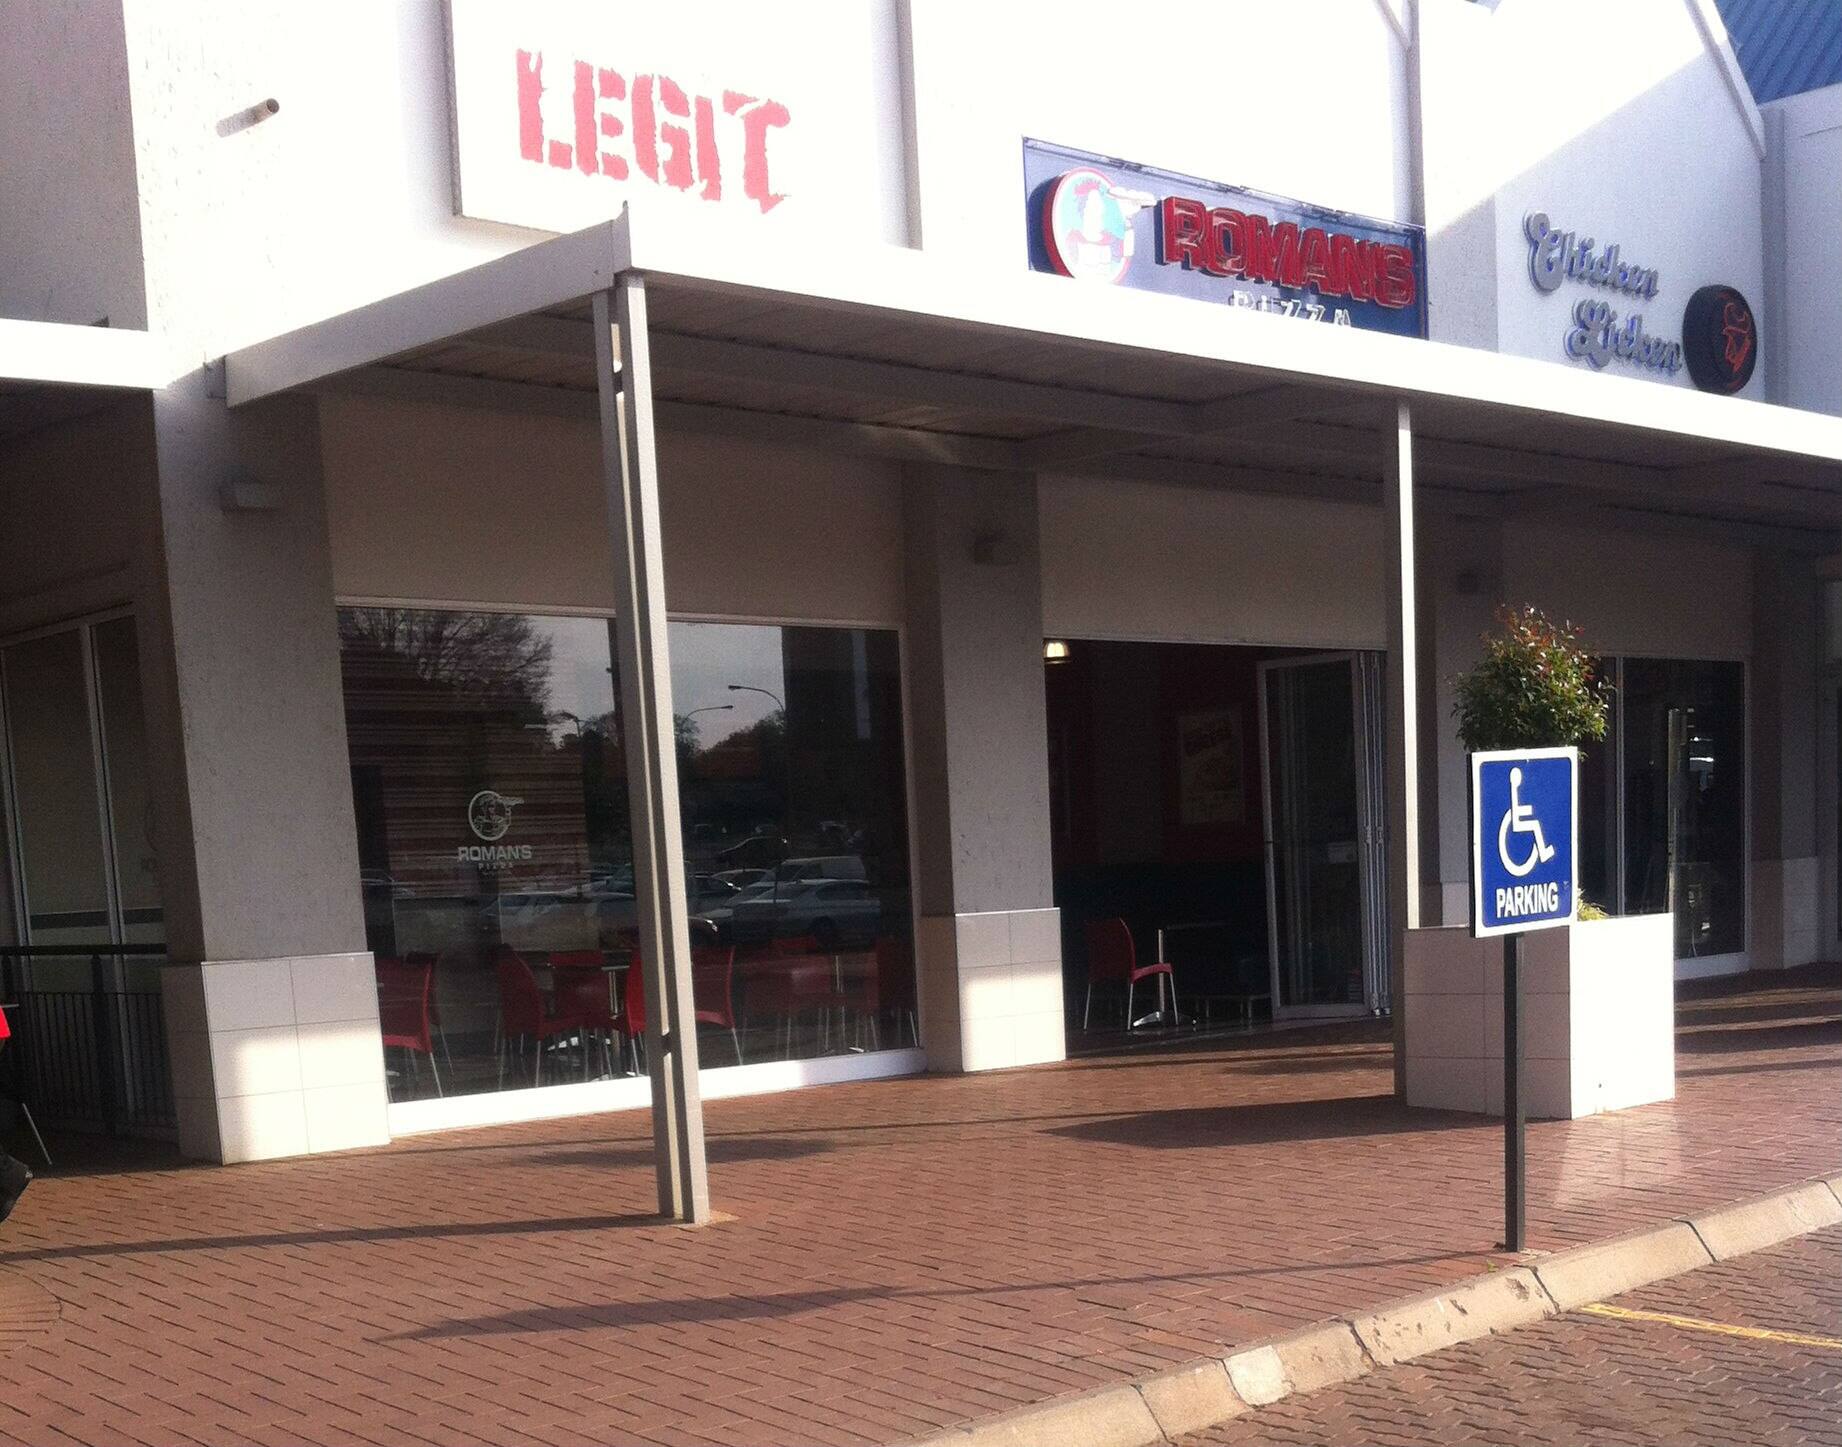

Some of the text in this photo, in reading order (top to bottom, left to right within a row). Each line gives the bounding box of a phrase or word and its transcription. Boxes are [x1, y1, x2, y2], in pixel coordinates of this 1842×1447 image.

[516, 48, 791, 214] LEGIT
[1523, 210, 1659, 298] Chicken
[1496, 883, 1558, 918] PARKING
